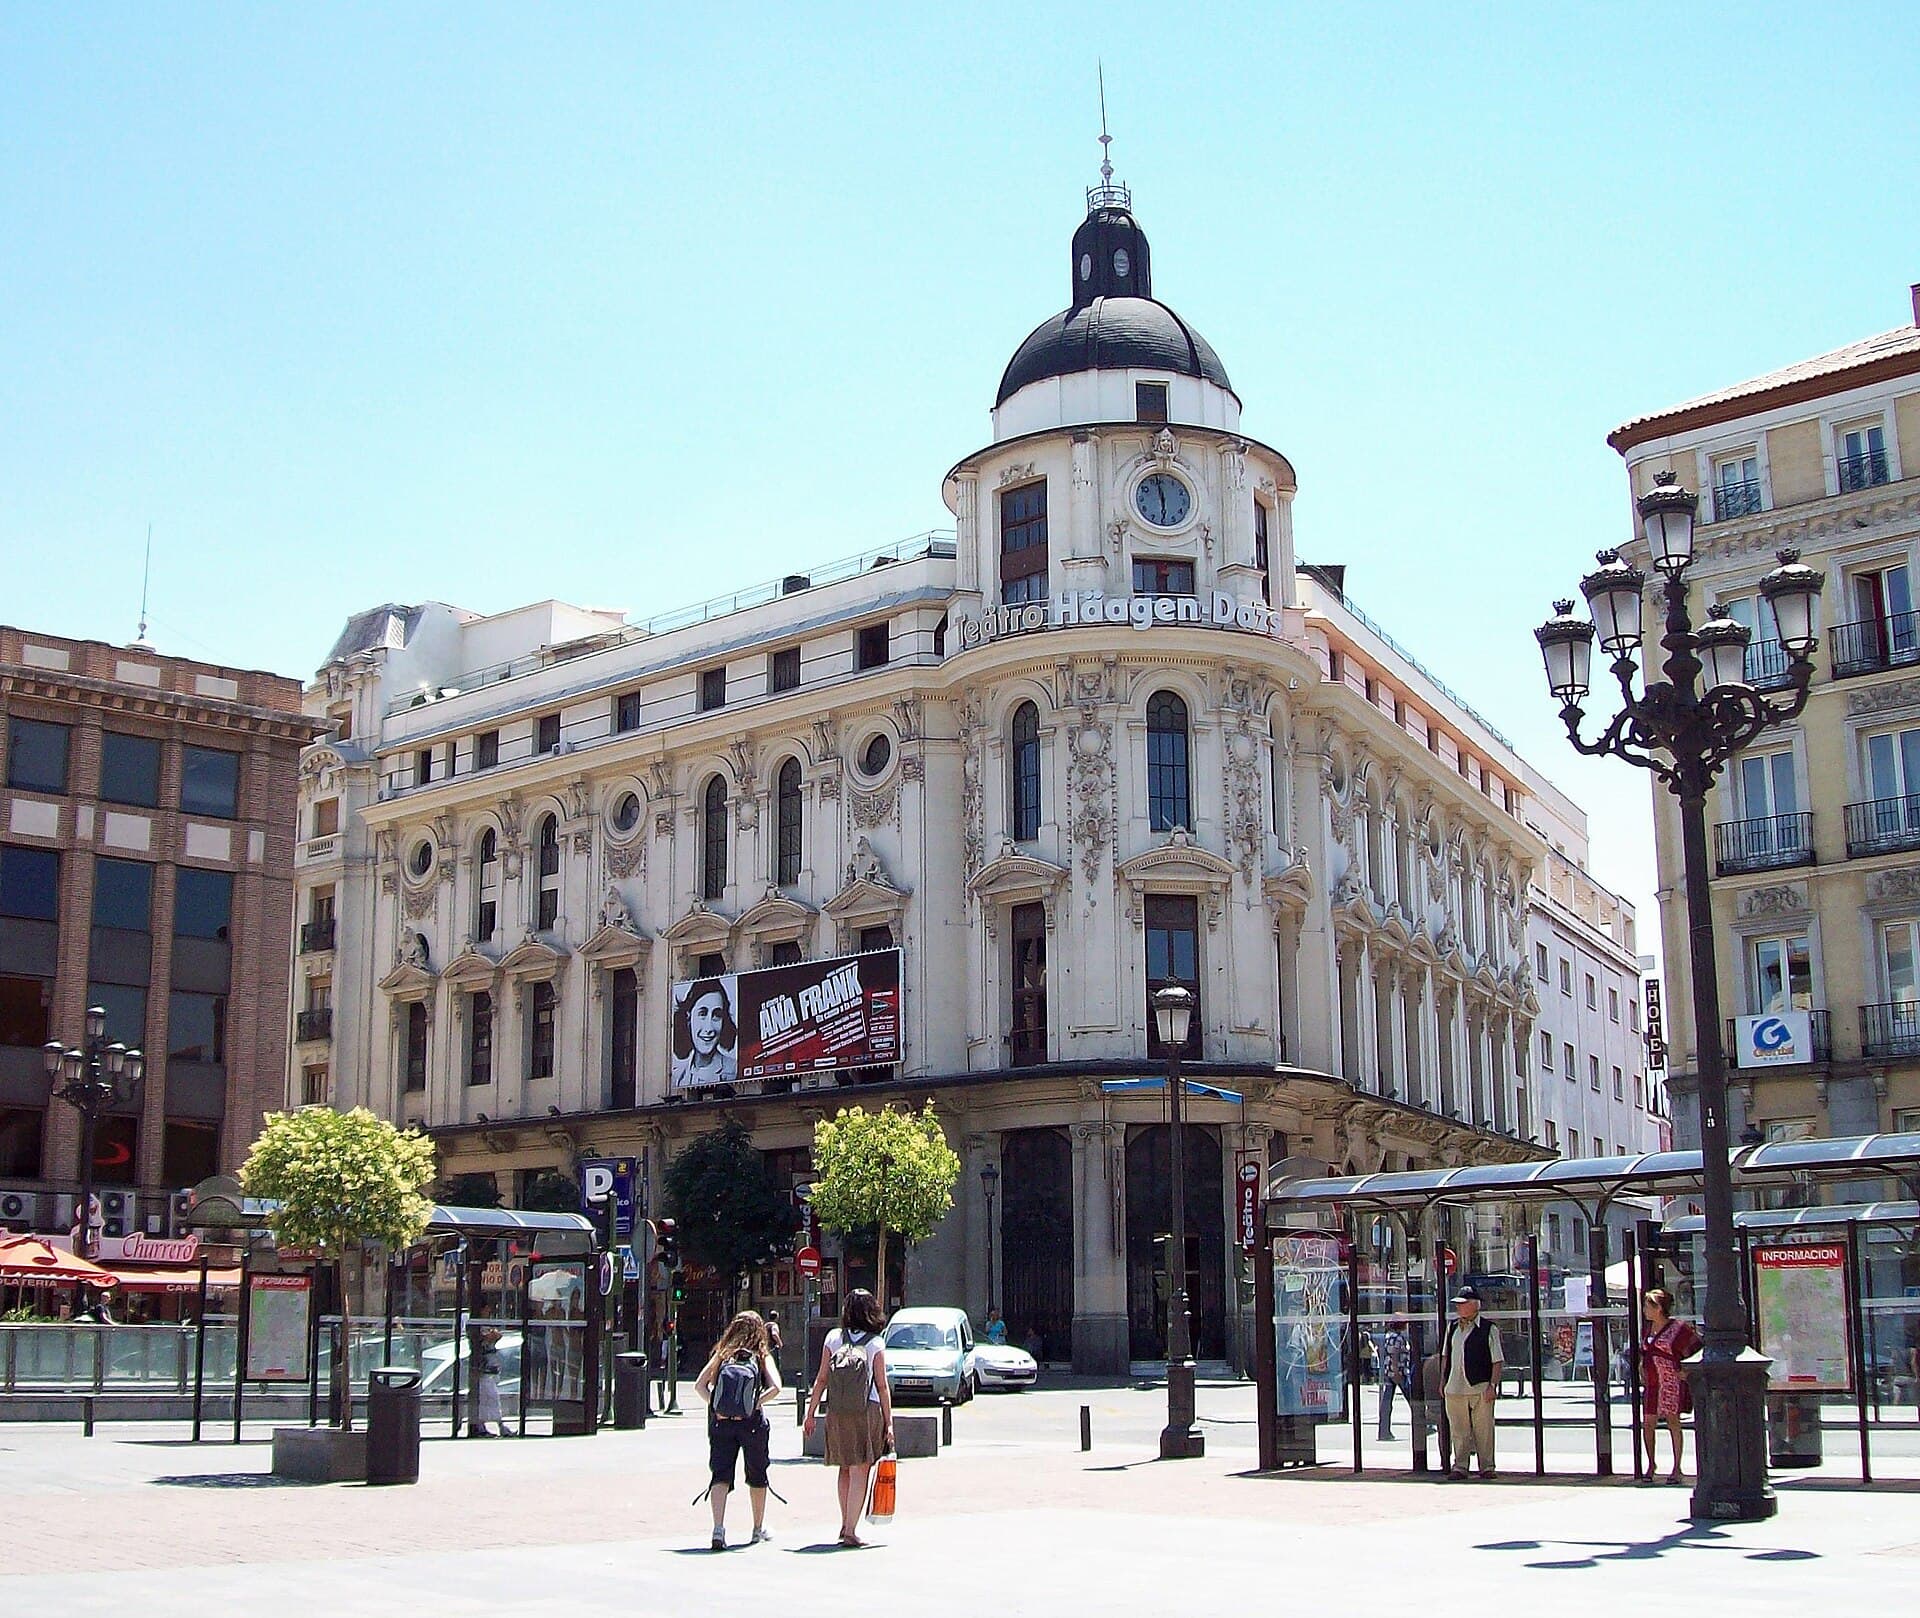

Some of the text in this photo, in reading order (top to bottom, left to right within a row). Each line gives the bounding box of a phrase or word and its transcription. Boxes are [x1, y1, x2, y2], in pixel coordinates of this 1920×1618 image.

[760, 997, 799, 1040] ANA
[799, 965, 863, 1021] FRANK
[1647, 989, 1663, 1068] HOTEL
[585, 1168, 614, 1208] P
[122, 1232, 197, 1260] Churrero
[1762, 1249, 1838, 1262] INFORMACION
